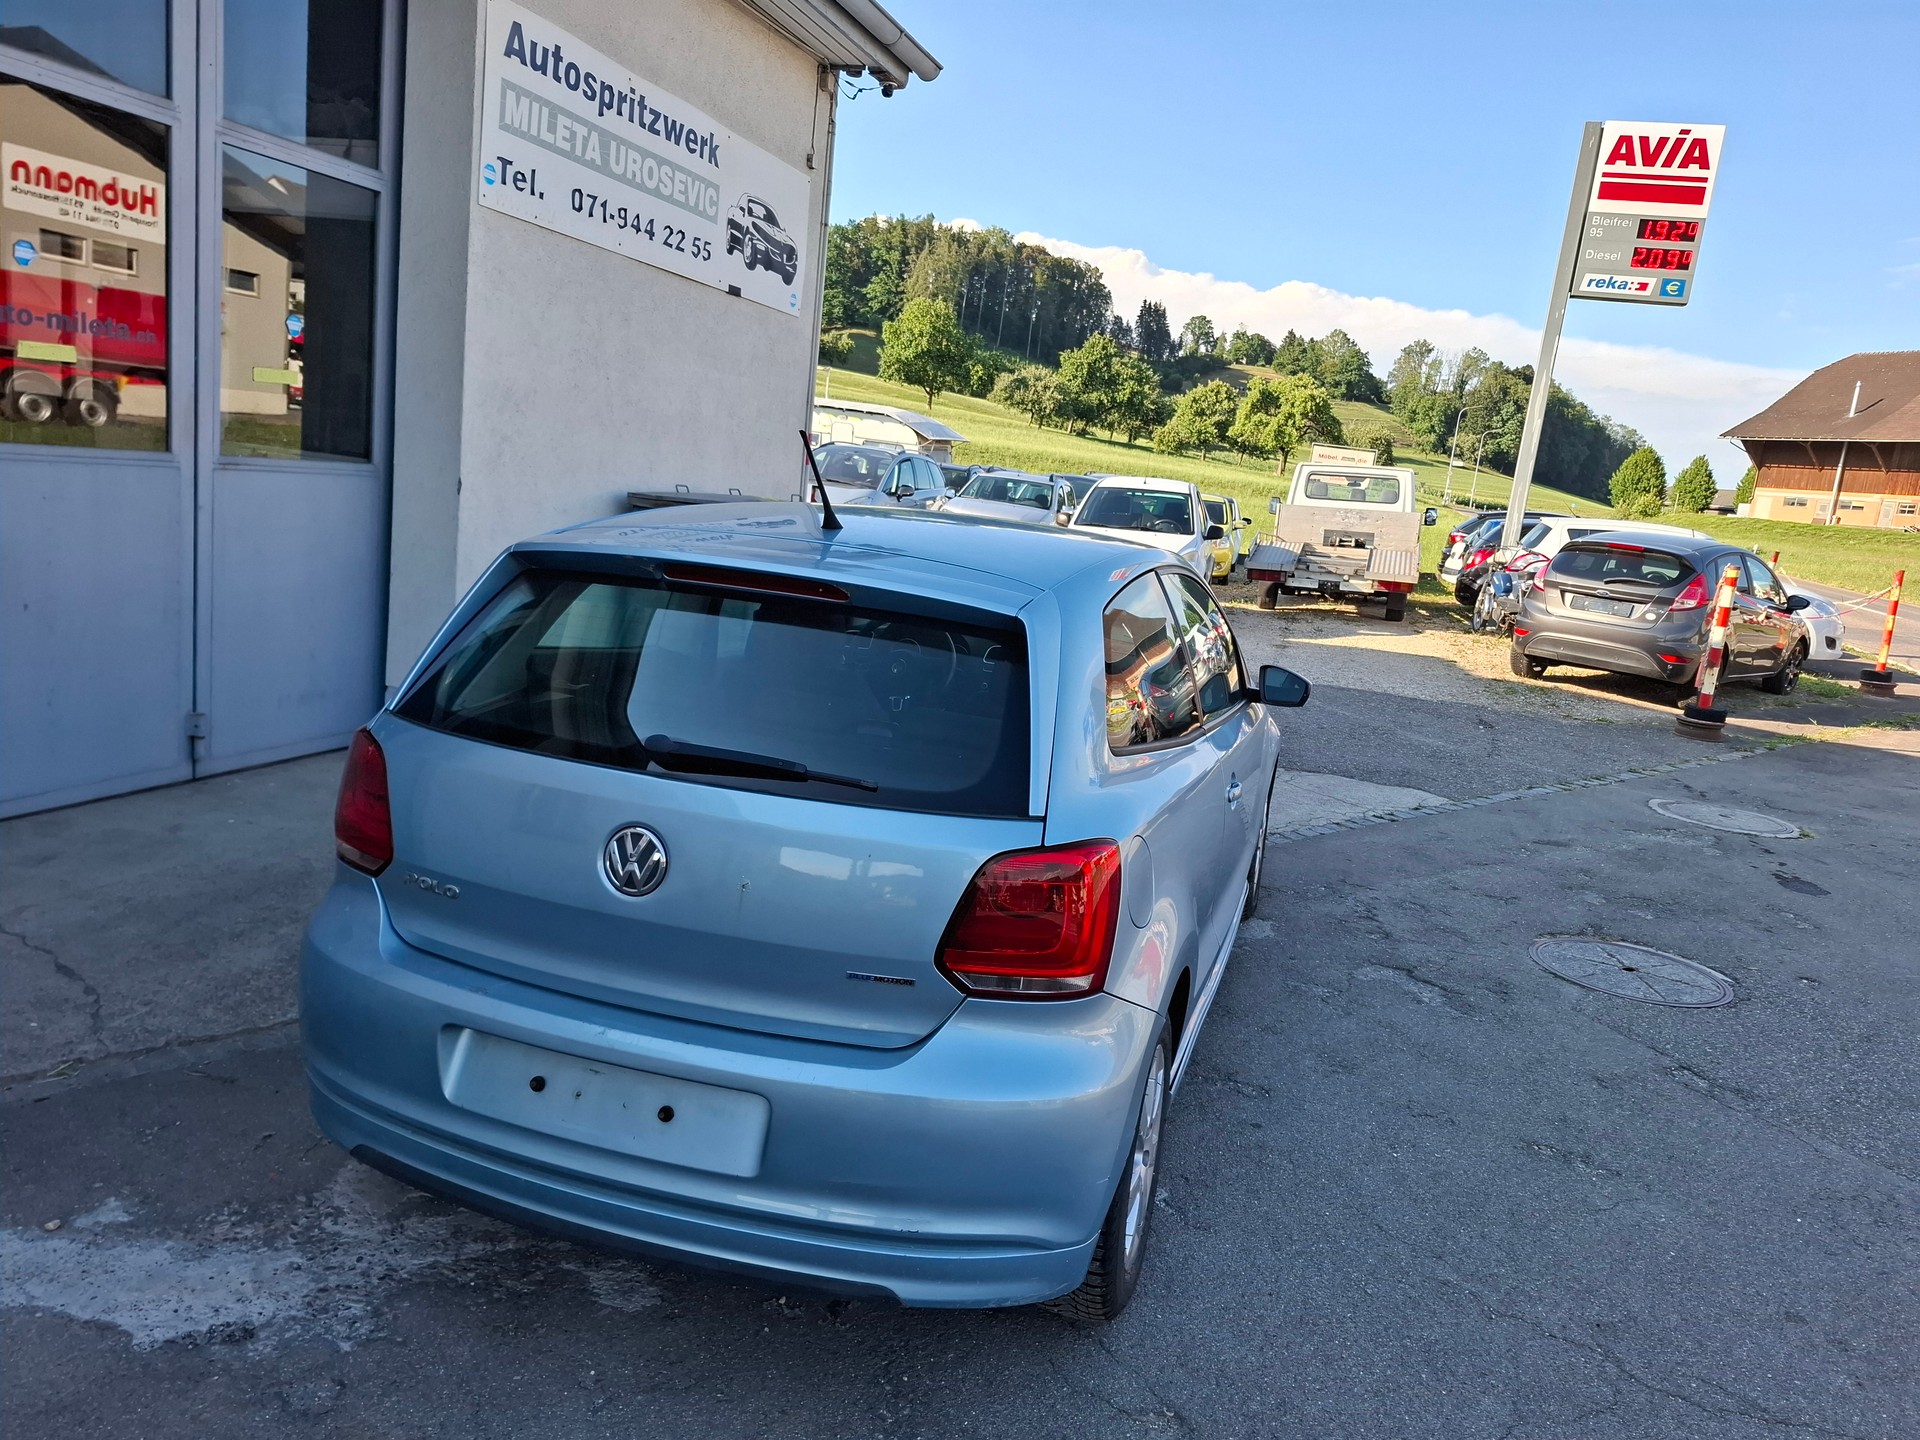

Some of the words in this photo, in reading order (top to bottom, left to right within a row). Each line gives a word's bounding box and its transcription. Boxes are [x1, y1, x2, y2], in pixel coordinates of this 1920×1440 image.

[503, 20, 720, 169] Autospritzwerk
[505, 90, 601, 166] MILETA
[610, 140, 719, 217] UROSEVIC
[1604, 129, 1710, 170] AVIA
[496, 156, 545, 200] Tel.
[571, 188, 656, 241] 071-944
[663, 225, 686, 253] 22
[691, 238, 712, 262] 55
[1591, 216, 1633, 228] Bleifrei
[1589, 227, 1604, 238] 95
[1585, 250, 1621, 261] Diesel
[0, 302, 157, 343] to-mileta.ch
[403, 871, 461, 899] POLO
